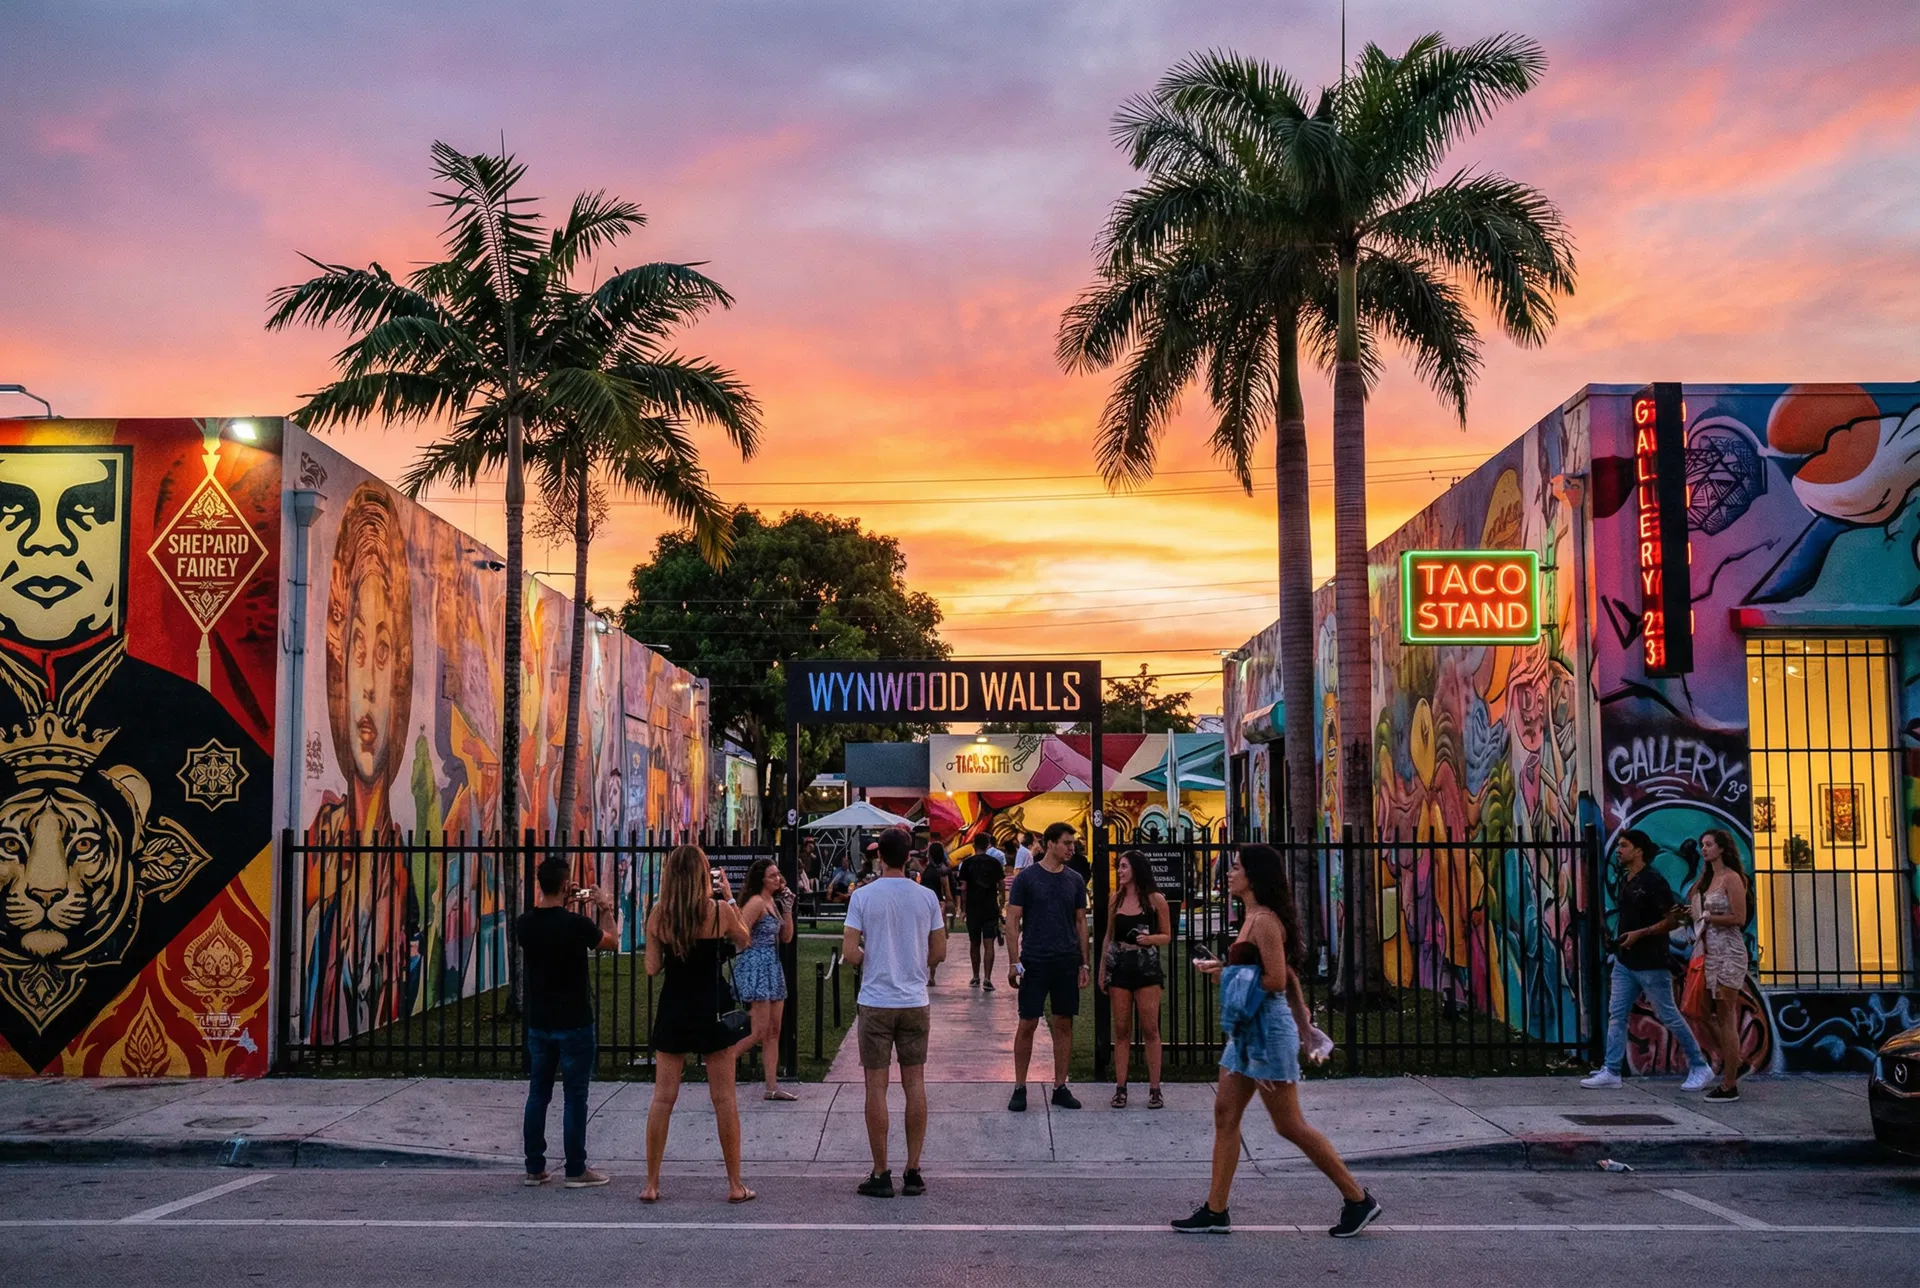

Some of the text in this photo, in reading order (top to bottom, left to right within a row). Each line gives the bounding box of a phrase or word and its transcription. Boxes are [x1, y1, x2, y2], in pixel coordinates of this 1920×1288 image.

[168, 534, 249, 554] SHEPARD
[1635, 400, 1658, 665] GALLERY 23
[177, 557, 239, 577] FAIREY
[1416, 564, 1527, 595] TACO
[1418, 602, 1528, 629] STAND
[808, 672, 1080, 711] WYNWOOD WALLS
[1608, 735, 1743, 798] GALLERY
